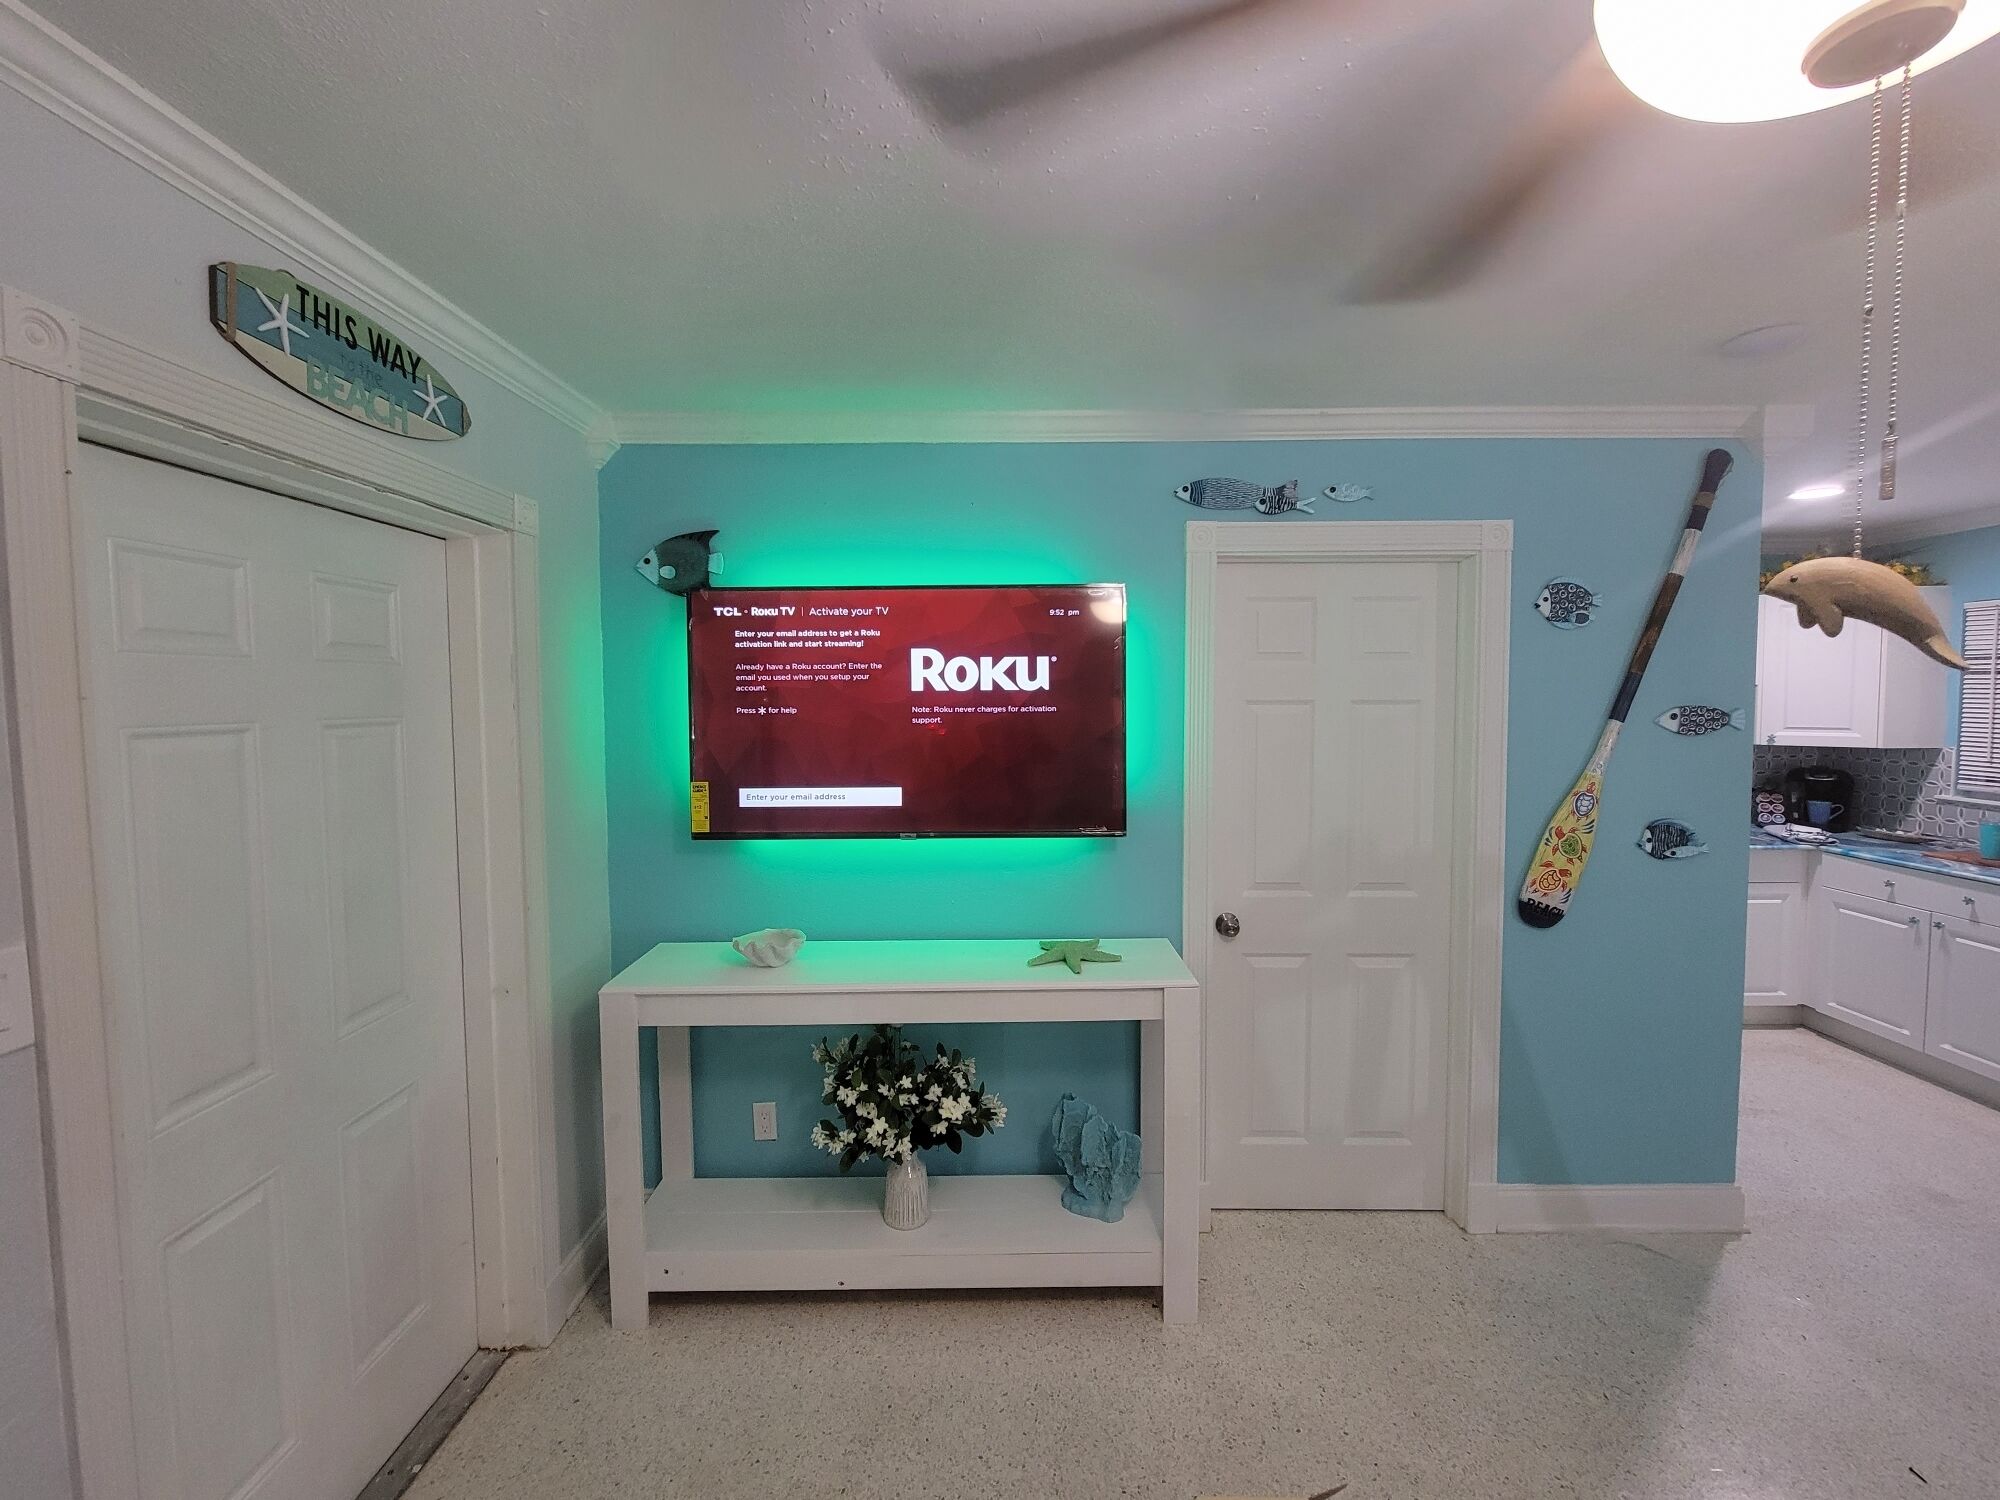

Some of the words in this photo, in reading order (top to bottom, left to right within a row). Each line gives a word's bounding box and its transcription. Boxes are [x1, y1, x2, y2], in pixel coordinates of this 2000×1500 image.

[296, 284, 357, 350] THIS
[368, 327, 422, 384] WAY
[306, 354, 409, 435] BEACH
[714, 607, 742, 616] TCL
[751, 607, 778, 616] Roku
[780, 607, 795, 616] TV
[809, 607, 848, 616] Activate
[851, 608, 872, 618] your
[875, 606, 889, 615] TV
[757, 631, 774, 639] your
[839, 630, 852, 638] get
[824, 640, 864, 648] streaming!
[736, 663, 764, 671] Already
[910, 647, 1050, 692] Roku
[781, 707, 797, 715] help
[977, 706, 1006, 714] charges
[912, 717, 942, 725] support.
